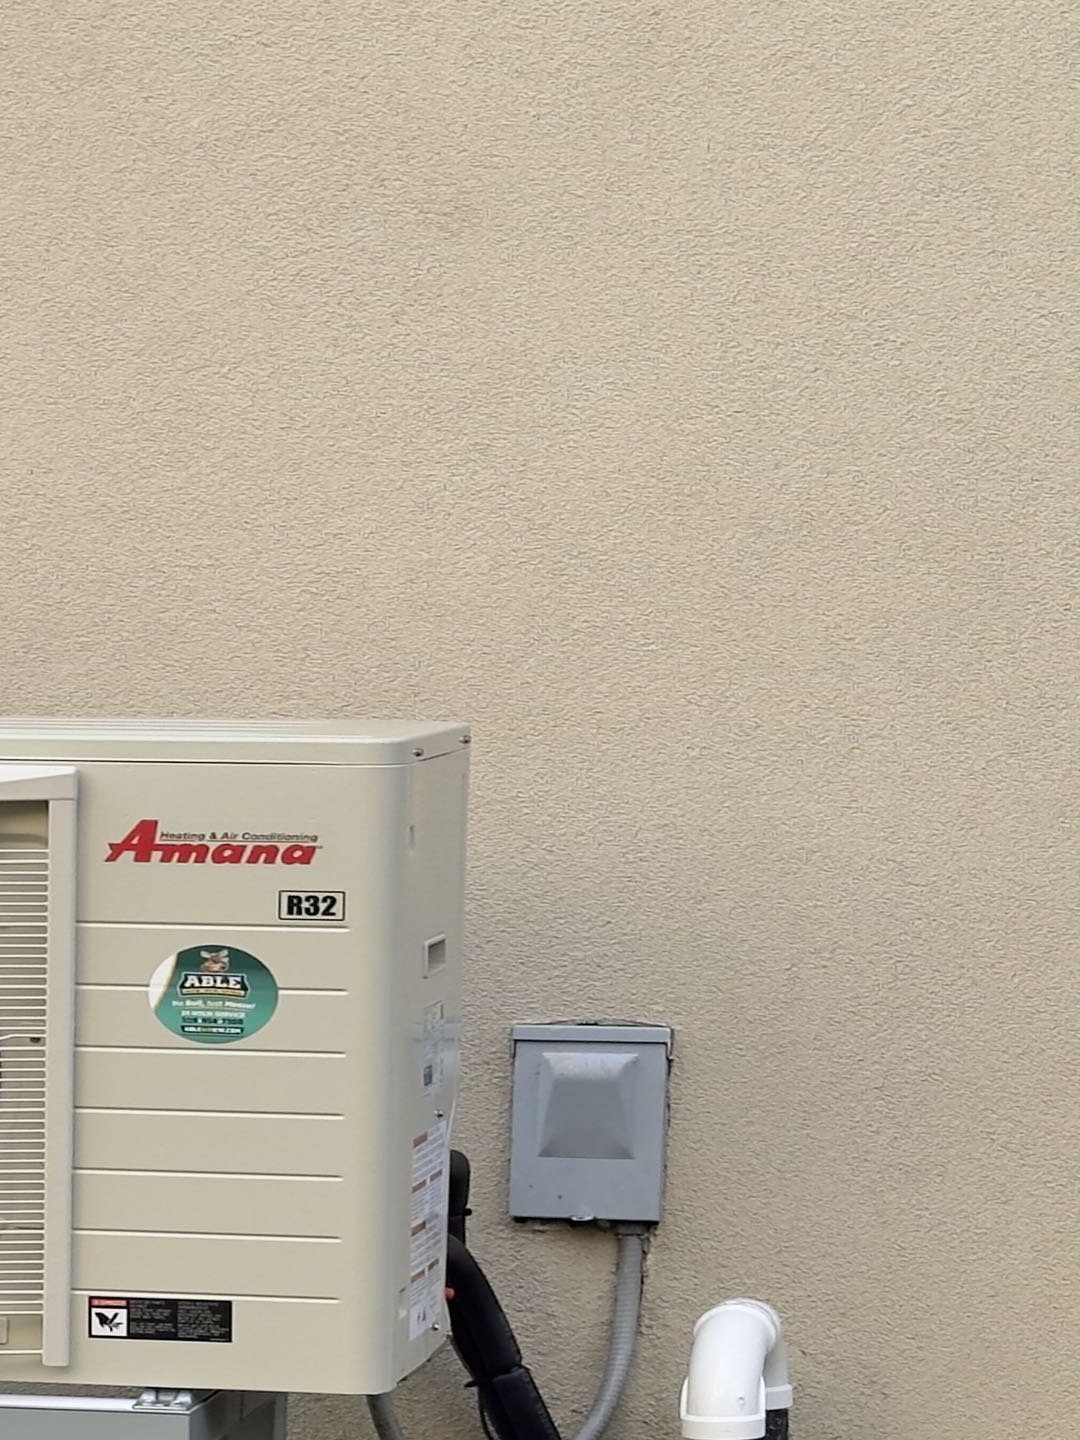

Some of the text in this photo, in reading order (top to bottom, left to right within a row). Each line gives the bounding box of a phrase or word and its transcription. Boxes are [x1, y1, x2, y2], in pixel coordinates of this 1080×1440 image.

[104, 819, 318, 865] Amana
[160, 831, 318, 843] Heating & Air Conditioning
[286, 895, 337, 916] R32
[184, 975, 242, 989] ABLE
